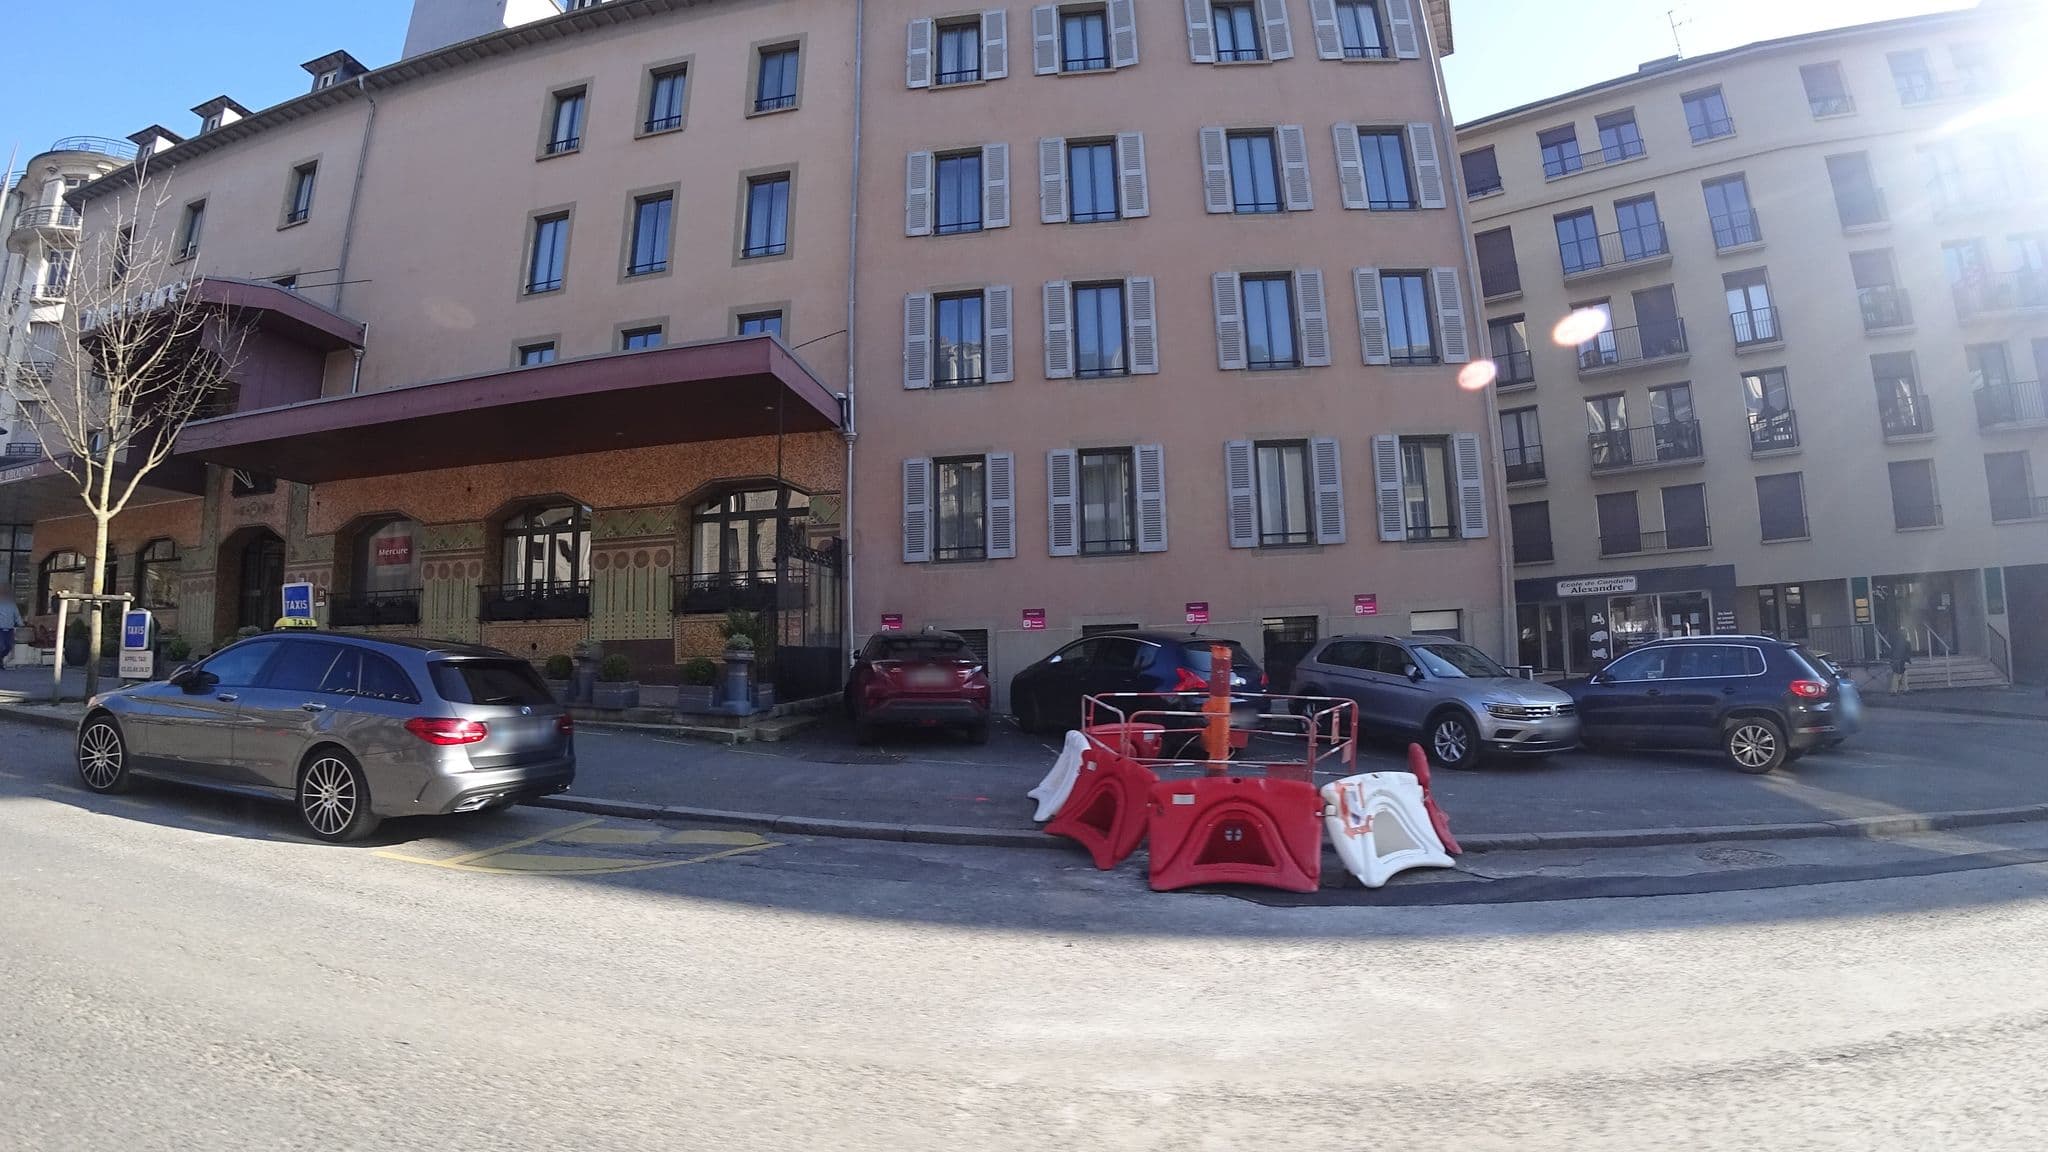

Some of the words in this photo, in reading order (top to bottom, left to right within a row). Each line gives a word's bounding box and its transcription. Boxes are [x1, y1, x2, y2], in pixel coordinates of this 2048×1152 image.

[378, 548, 409, 556] Mercure
[1597, 577, 1634, 586] Conduite
[1570, 583, 1624, 594] Alexandre
[286, 600, 308, 610] TAXIS
[292, 618, 313, 626] TAXI
[127, 625, 145, 635] TAXIS
